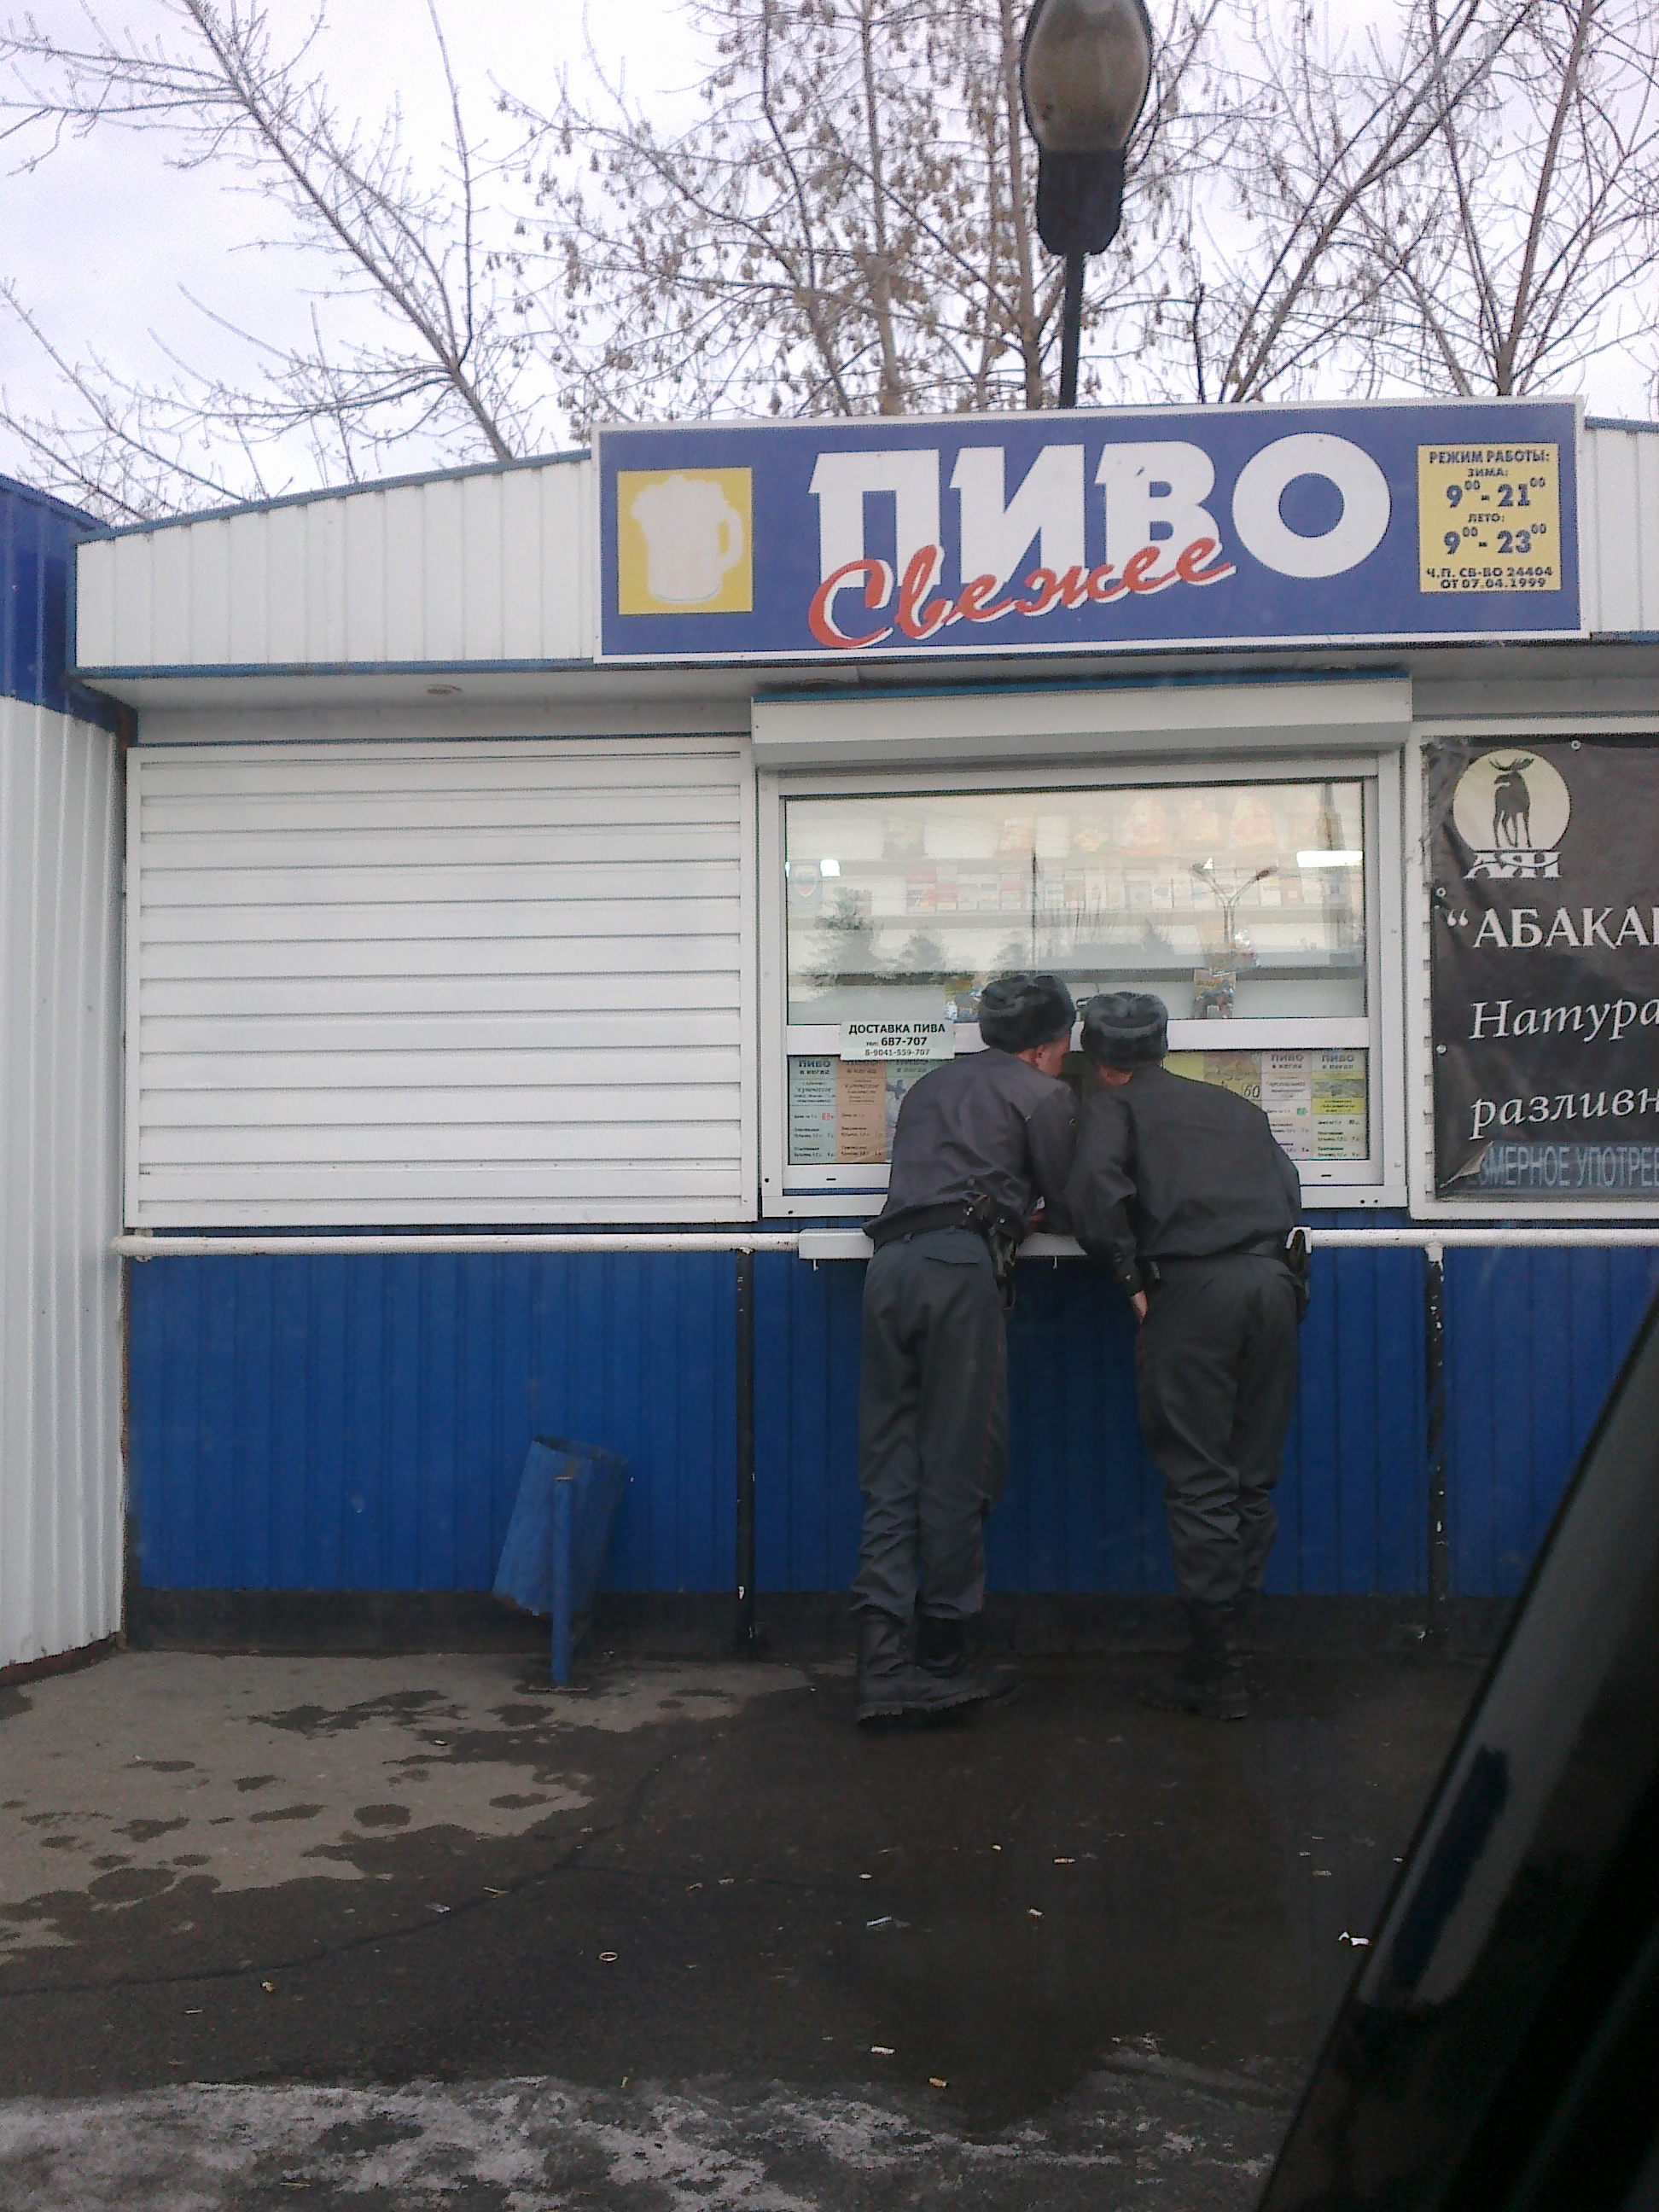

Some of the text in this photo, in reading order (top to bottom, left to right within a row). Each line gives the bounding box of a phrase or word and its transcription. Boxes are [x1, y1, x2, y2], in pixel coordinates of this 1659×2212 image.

[1429, 449, 1550, 463] РЕЖИМ РАБОТЫ:
[1468, 468, 1508, 477] ЗИМА:
[808, 432, 1392, 589] ПИВО
[1468, 513, 1505, 523] ЛЕТО:
[1459, 568, 1503, 578] СВ-ВО
[1507, 567, 1553, 577] 24404
[1441, 578, 1546, 589] ОТ 07.04.1999
[808, 537, 1236, 649] Свежее
[1463, 853, 1563, 880] АЯН
[1447, 905, 1659, 950] “АБАКА
[848, 1023, 946, 1035] ДОСТАВКА ПИВА
[881, 1037, 928, 1046] 687-707
